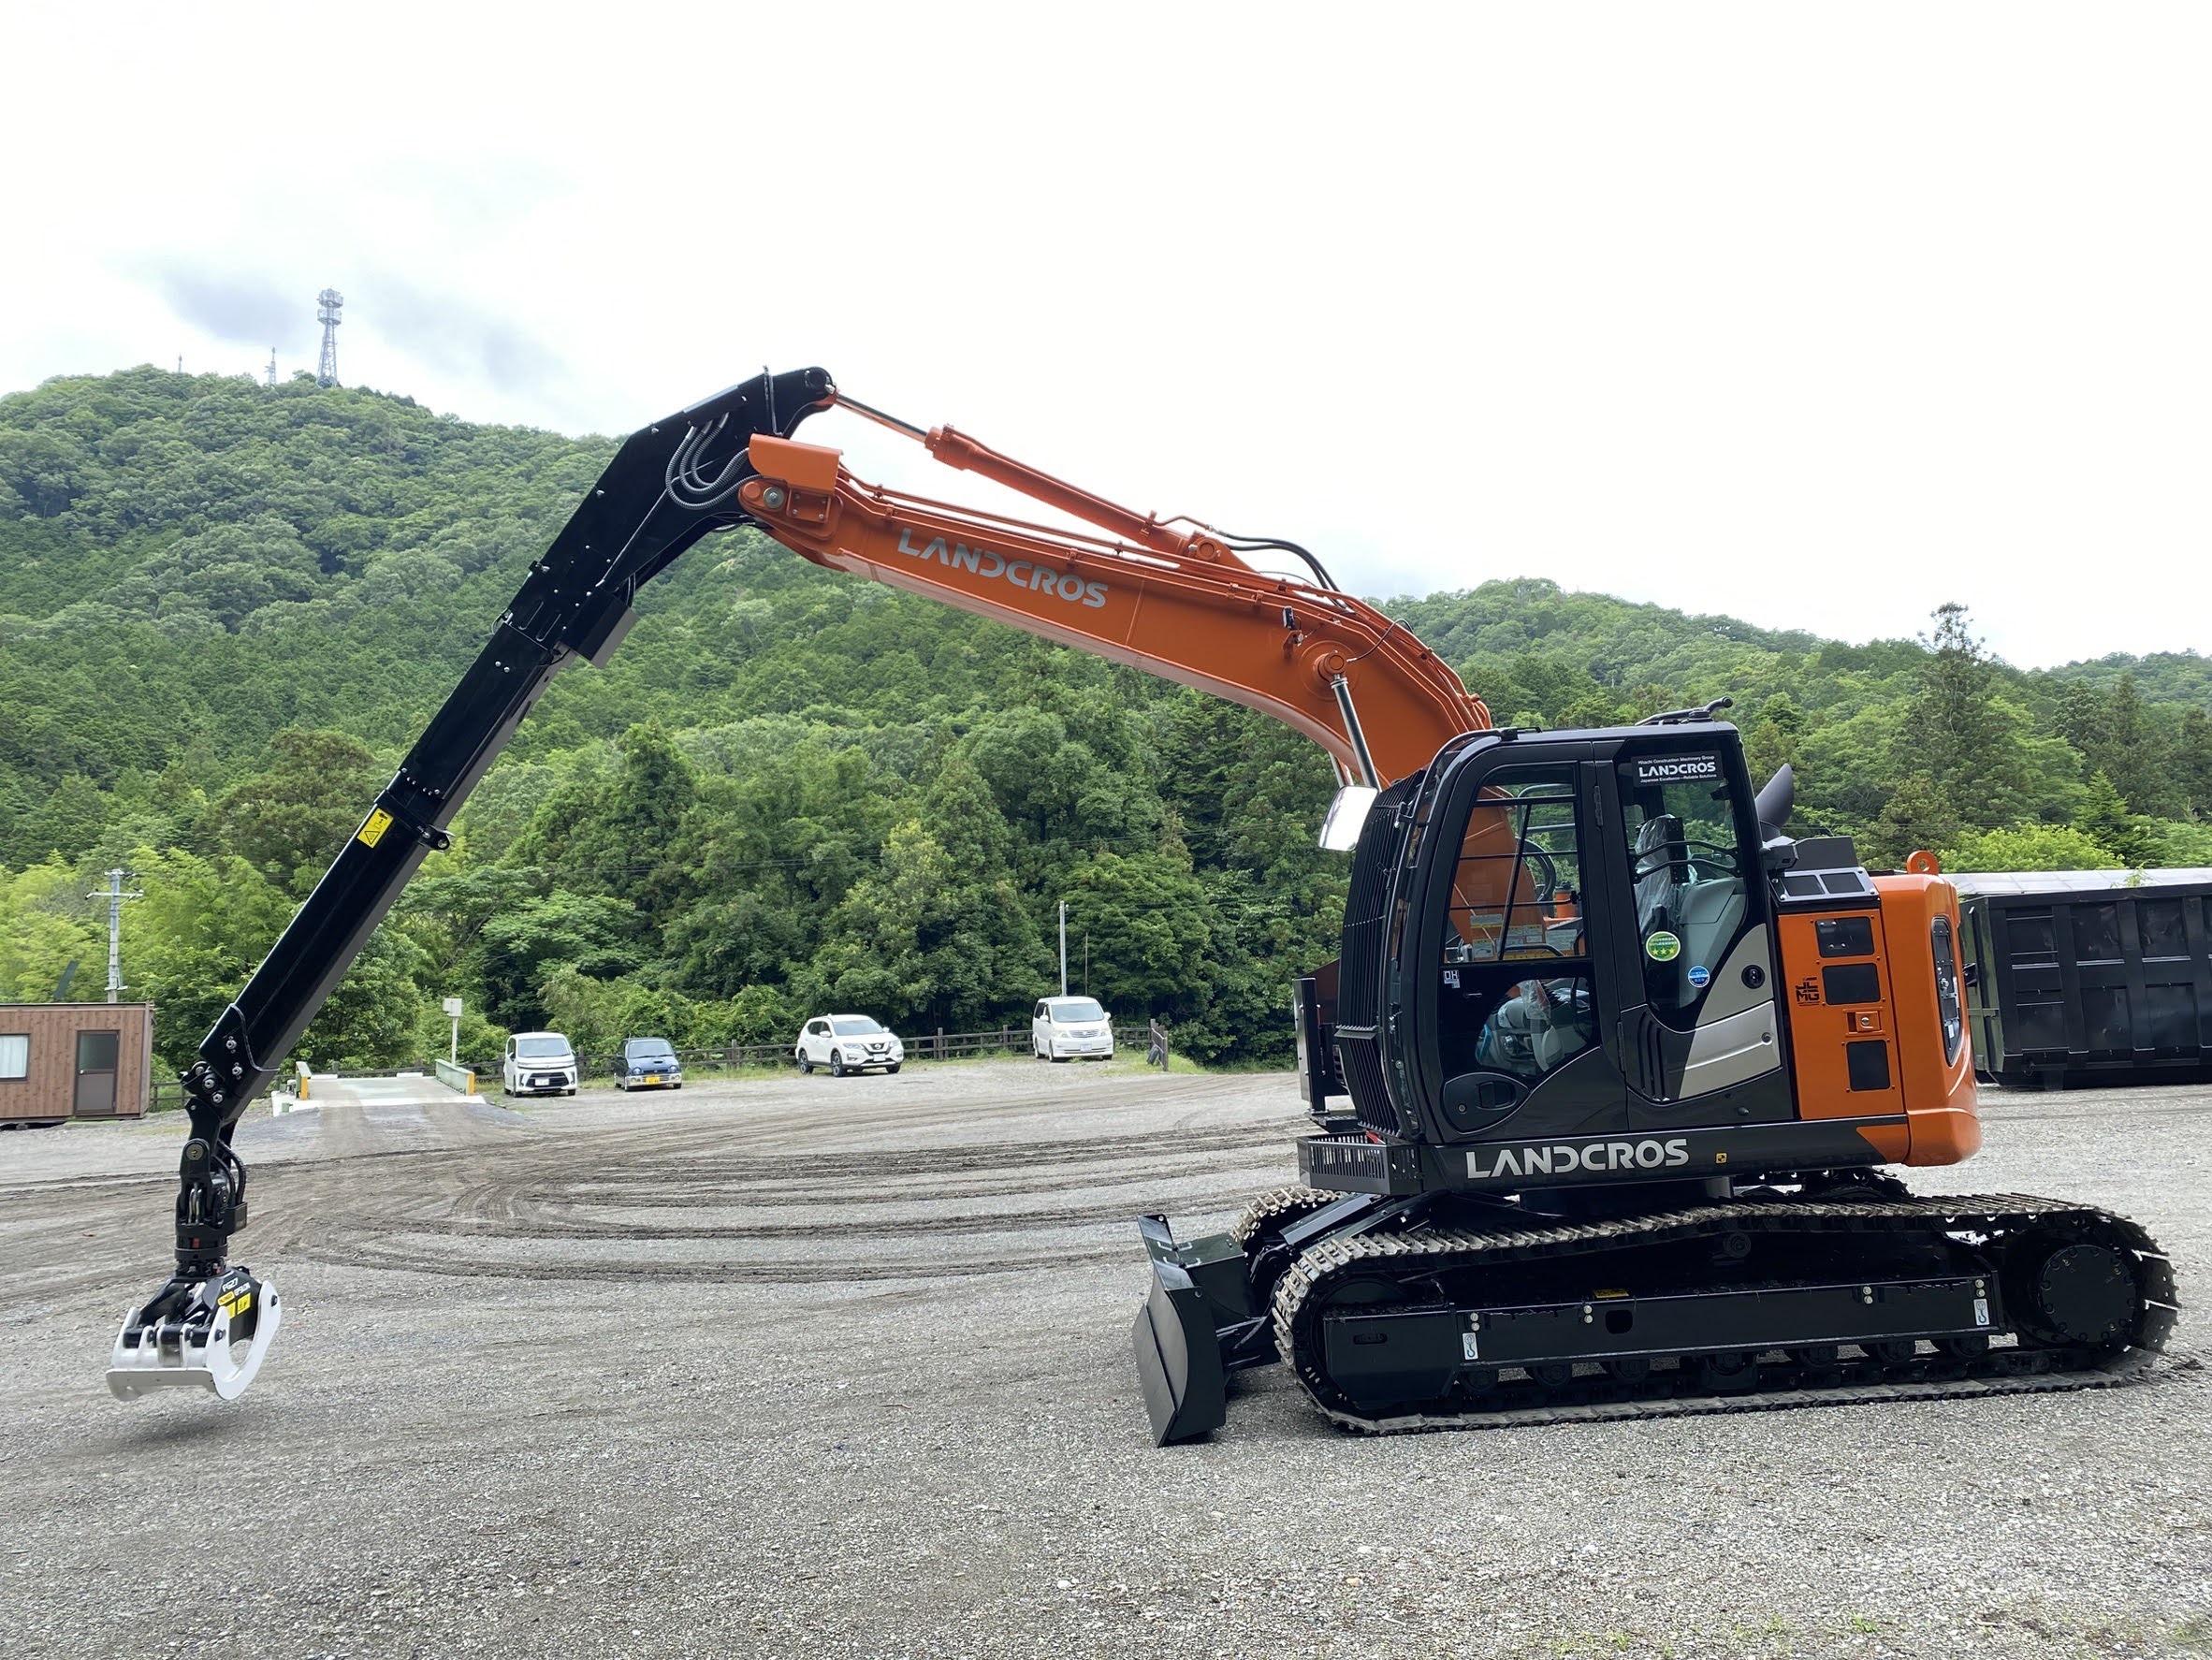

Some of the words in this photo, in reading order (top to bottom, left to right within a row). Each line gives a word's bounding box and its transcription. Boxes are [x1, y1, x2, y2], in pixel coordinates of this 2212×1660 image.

[897, 528, 1109, 608] LANDCROS
[1638, 762, 1716, 778] LANDCROS
[1466, 1139, 1689, 1179] LANDCROS
